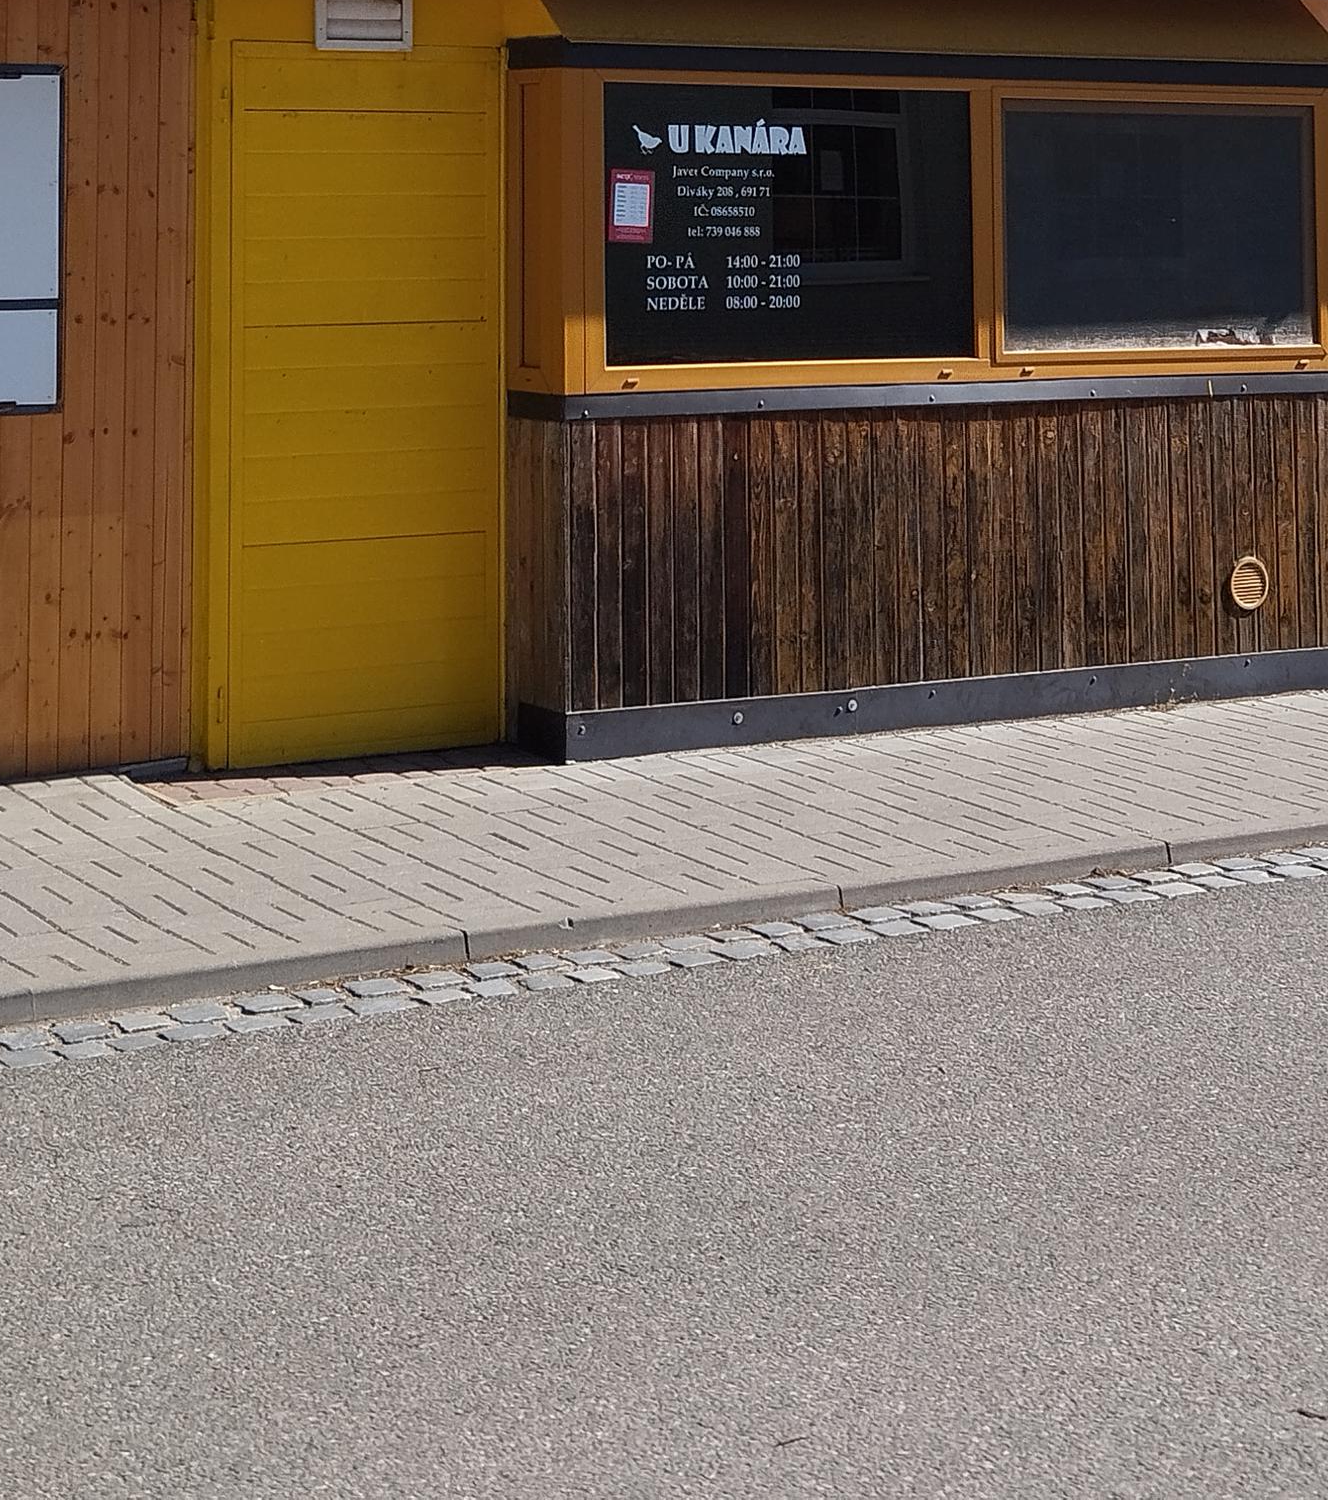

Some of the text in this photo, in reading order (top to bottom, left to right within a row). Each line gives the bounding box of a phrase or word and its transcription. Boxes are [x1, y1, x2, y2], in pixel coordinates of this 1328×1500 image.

[668, 118, 807, 155] U KANÁRA
[701, 165, 749, 180] Company
[752, 167, 775, 177] s.r.o.
[677, 185, 714, 200] Diváky
[716, 186, 734, 197] 208
[741, 186, 757, 197] 691
[759, 187, 770, 197] 71
[687, 226, 704, 237] tel:
[705, 226, 723, 237] 739
[676, 252, 695, 269] PÁ
[726, 255, 758, 268] 14:00
[769, 254, 801, 268] 21:00
[646, 275, 709, 290] SOBOTA
[726, 275, 758, 289] 10:00
[769, 275, 801, 288] 21:00
[646, 294, 706, 311] NEDĚLE
[726, 295, 758, 309] 08:00
[769, 295, 801, 308] 20:00
